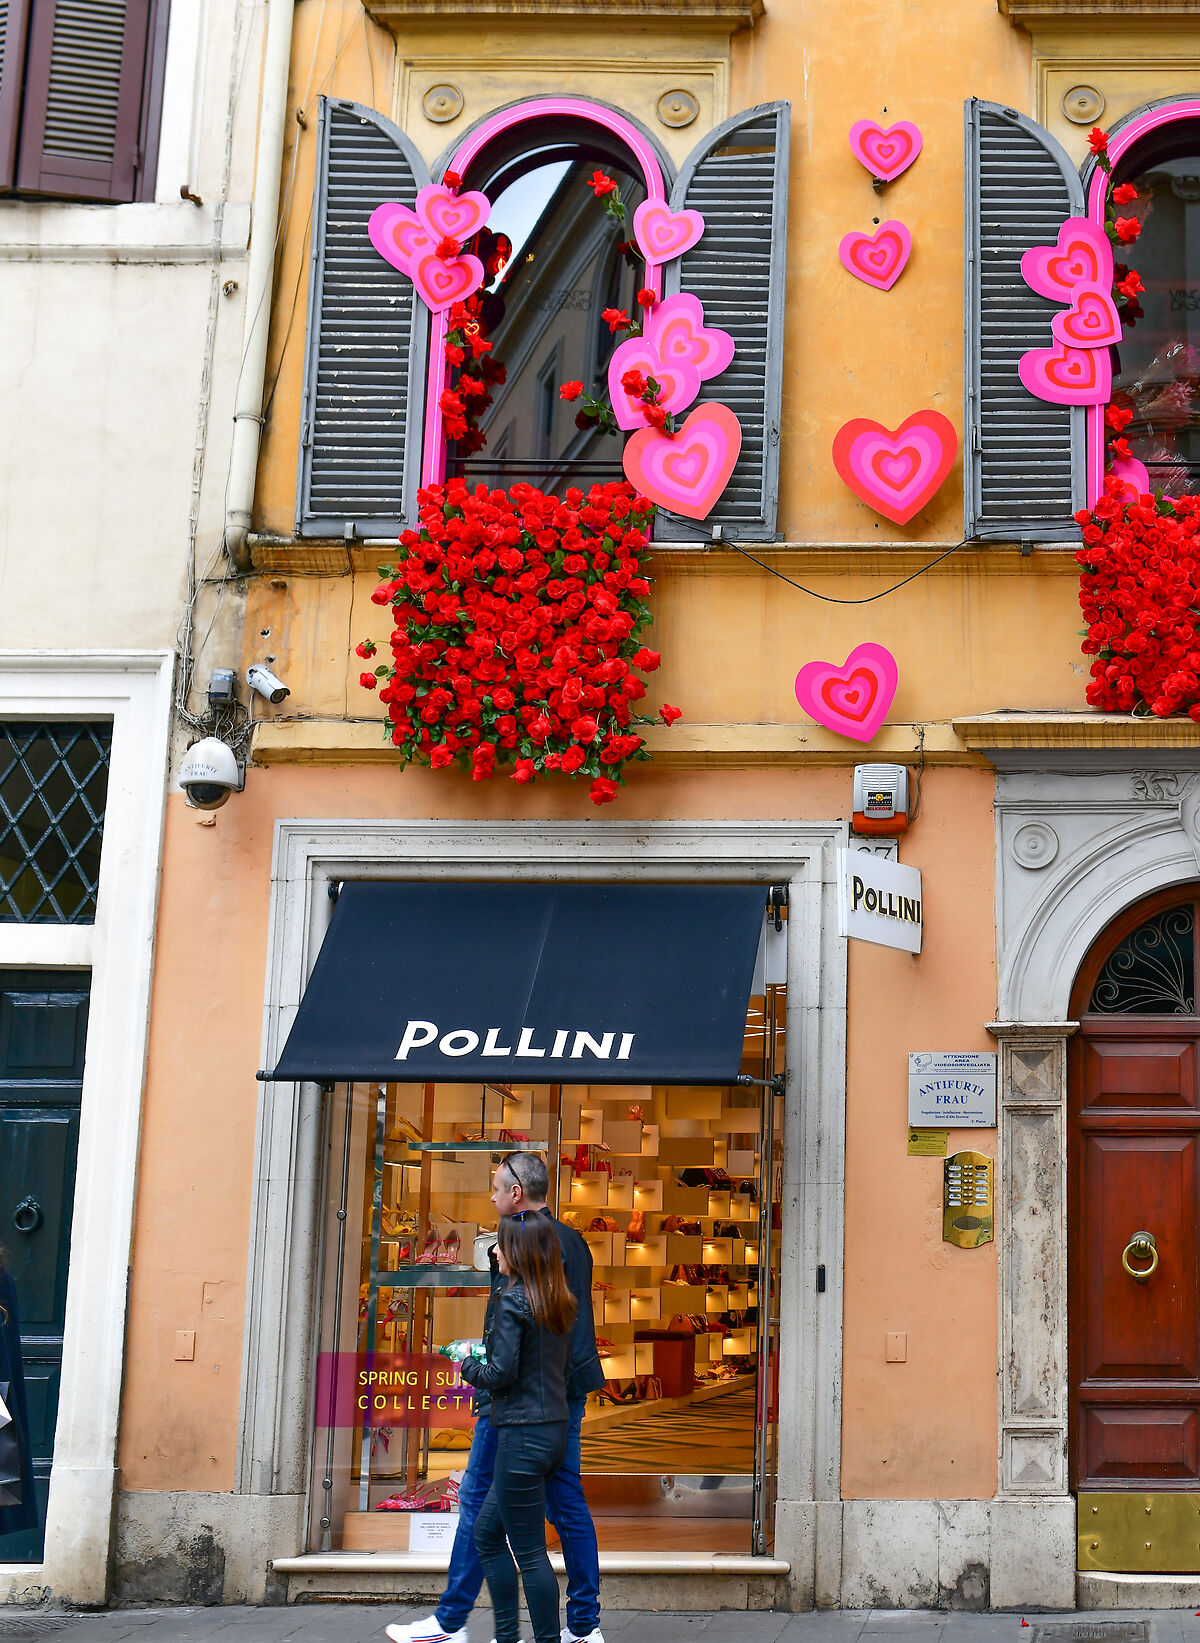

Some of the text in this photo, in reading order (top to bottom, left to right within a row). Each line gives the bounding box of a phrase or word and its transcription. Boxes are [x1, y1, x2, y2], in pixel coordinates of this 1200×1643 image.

[851, 874, 921, 925] POLLINI
[393, 1019, 637, 1061] POLLINI
[919, 1080, 985, 1096] ANTIFURTI
[936, 1095, 968, 1104] FRAU
[358, 1371, 418, 1386] SPRING
